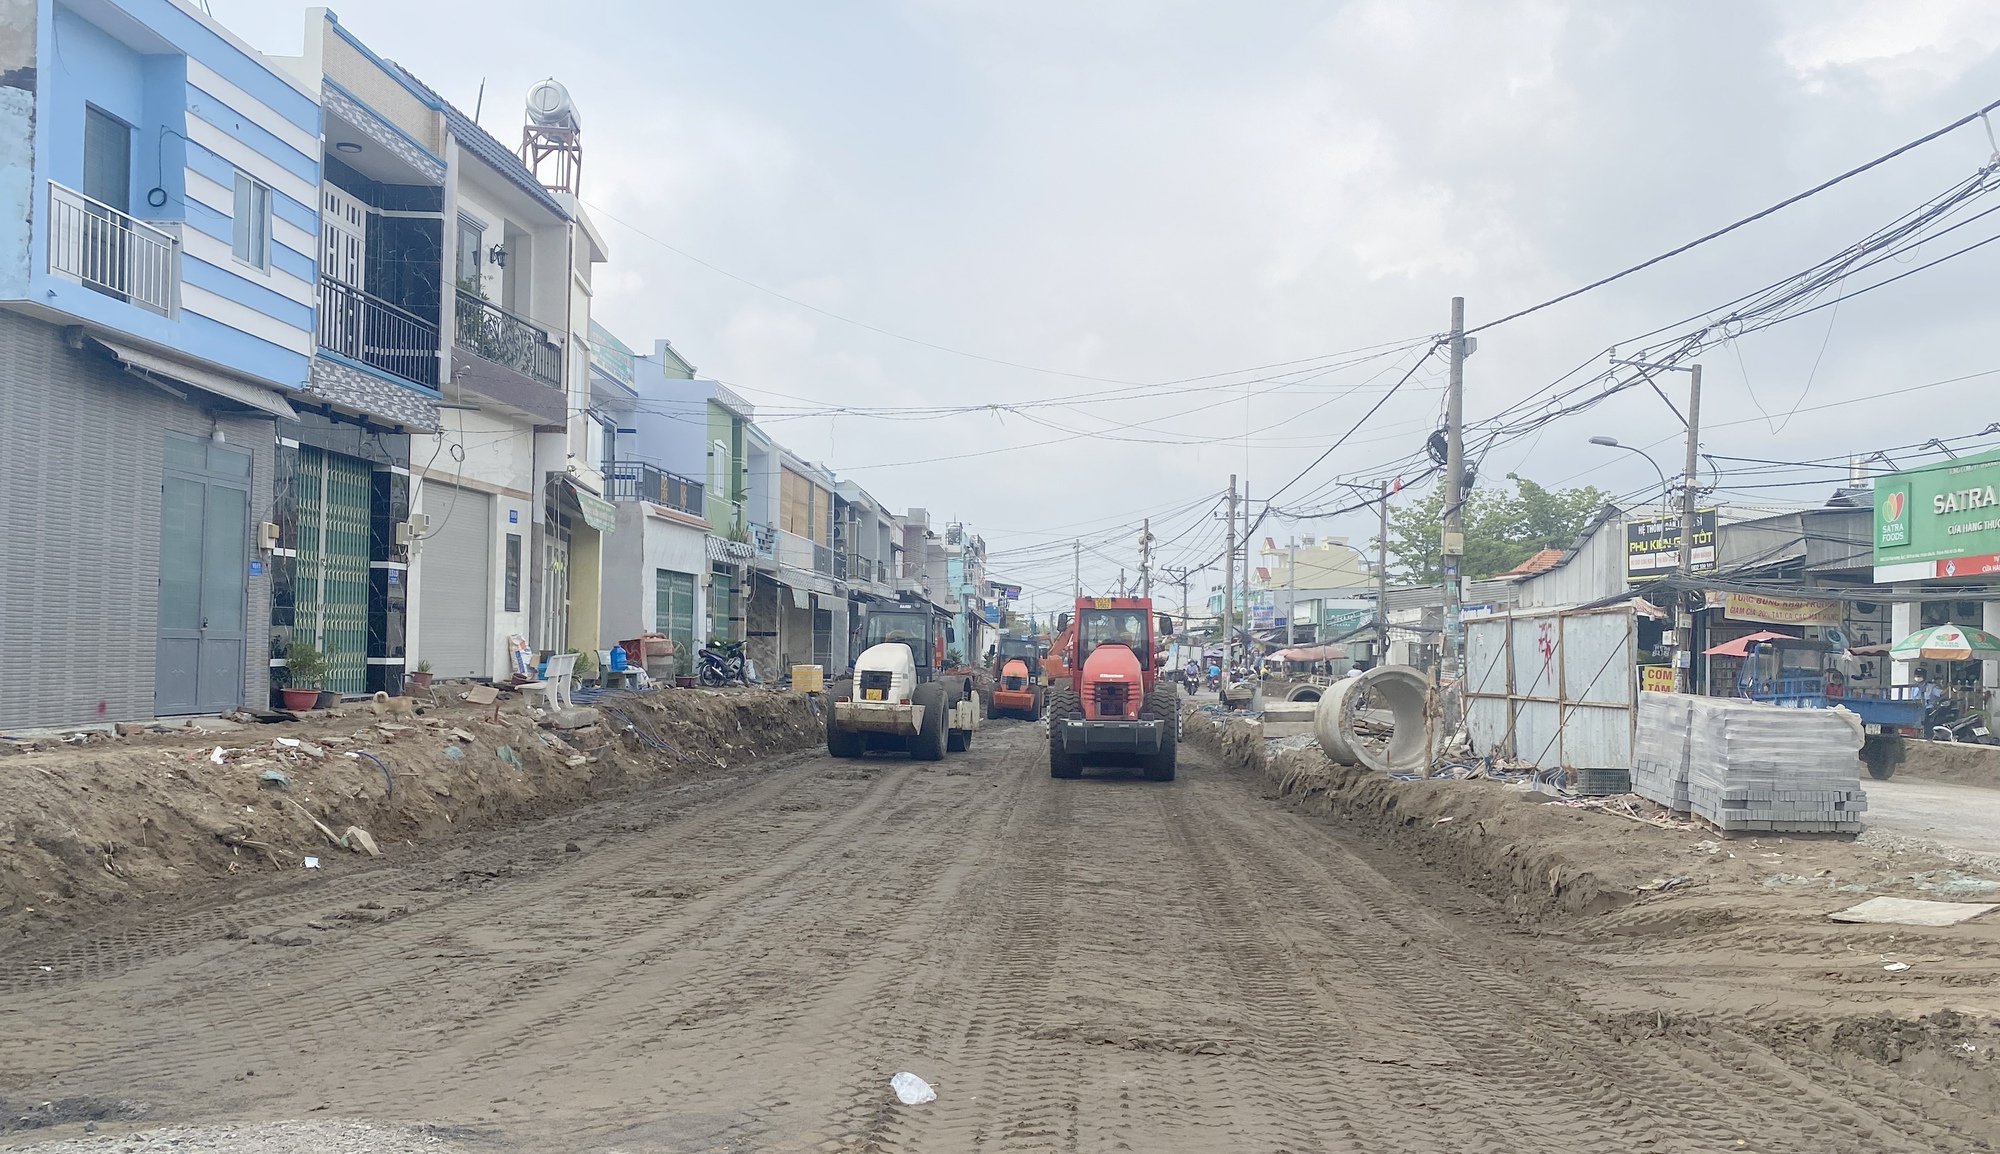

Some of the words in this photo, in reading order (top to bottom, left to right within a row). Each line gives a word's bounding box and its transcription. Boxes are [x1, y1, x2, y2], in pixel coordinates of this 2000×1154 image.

[1933, 485, 1997, 515] SATRA
[1882, 523, 1904, 534] SATRA
[1882, 532, 1904, 542] FOODS
[1629, 541, 1648, 553] PHỤ
[1692, 528, 1713, 545] TỐT
